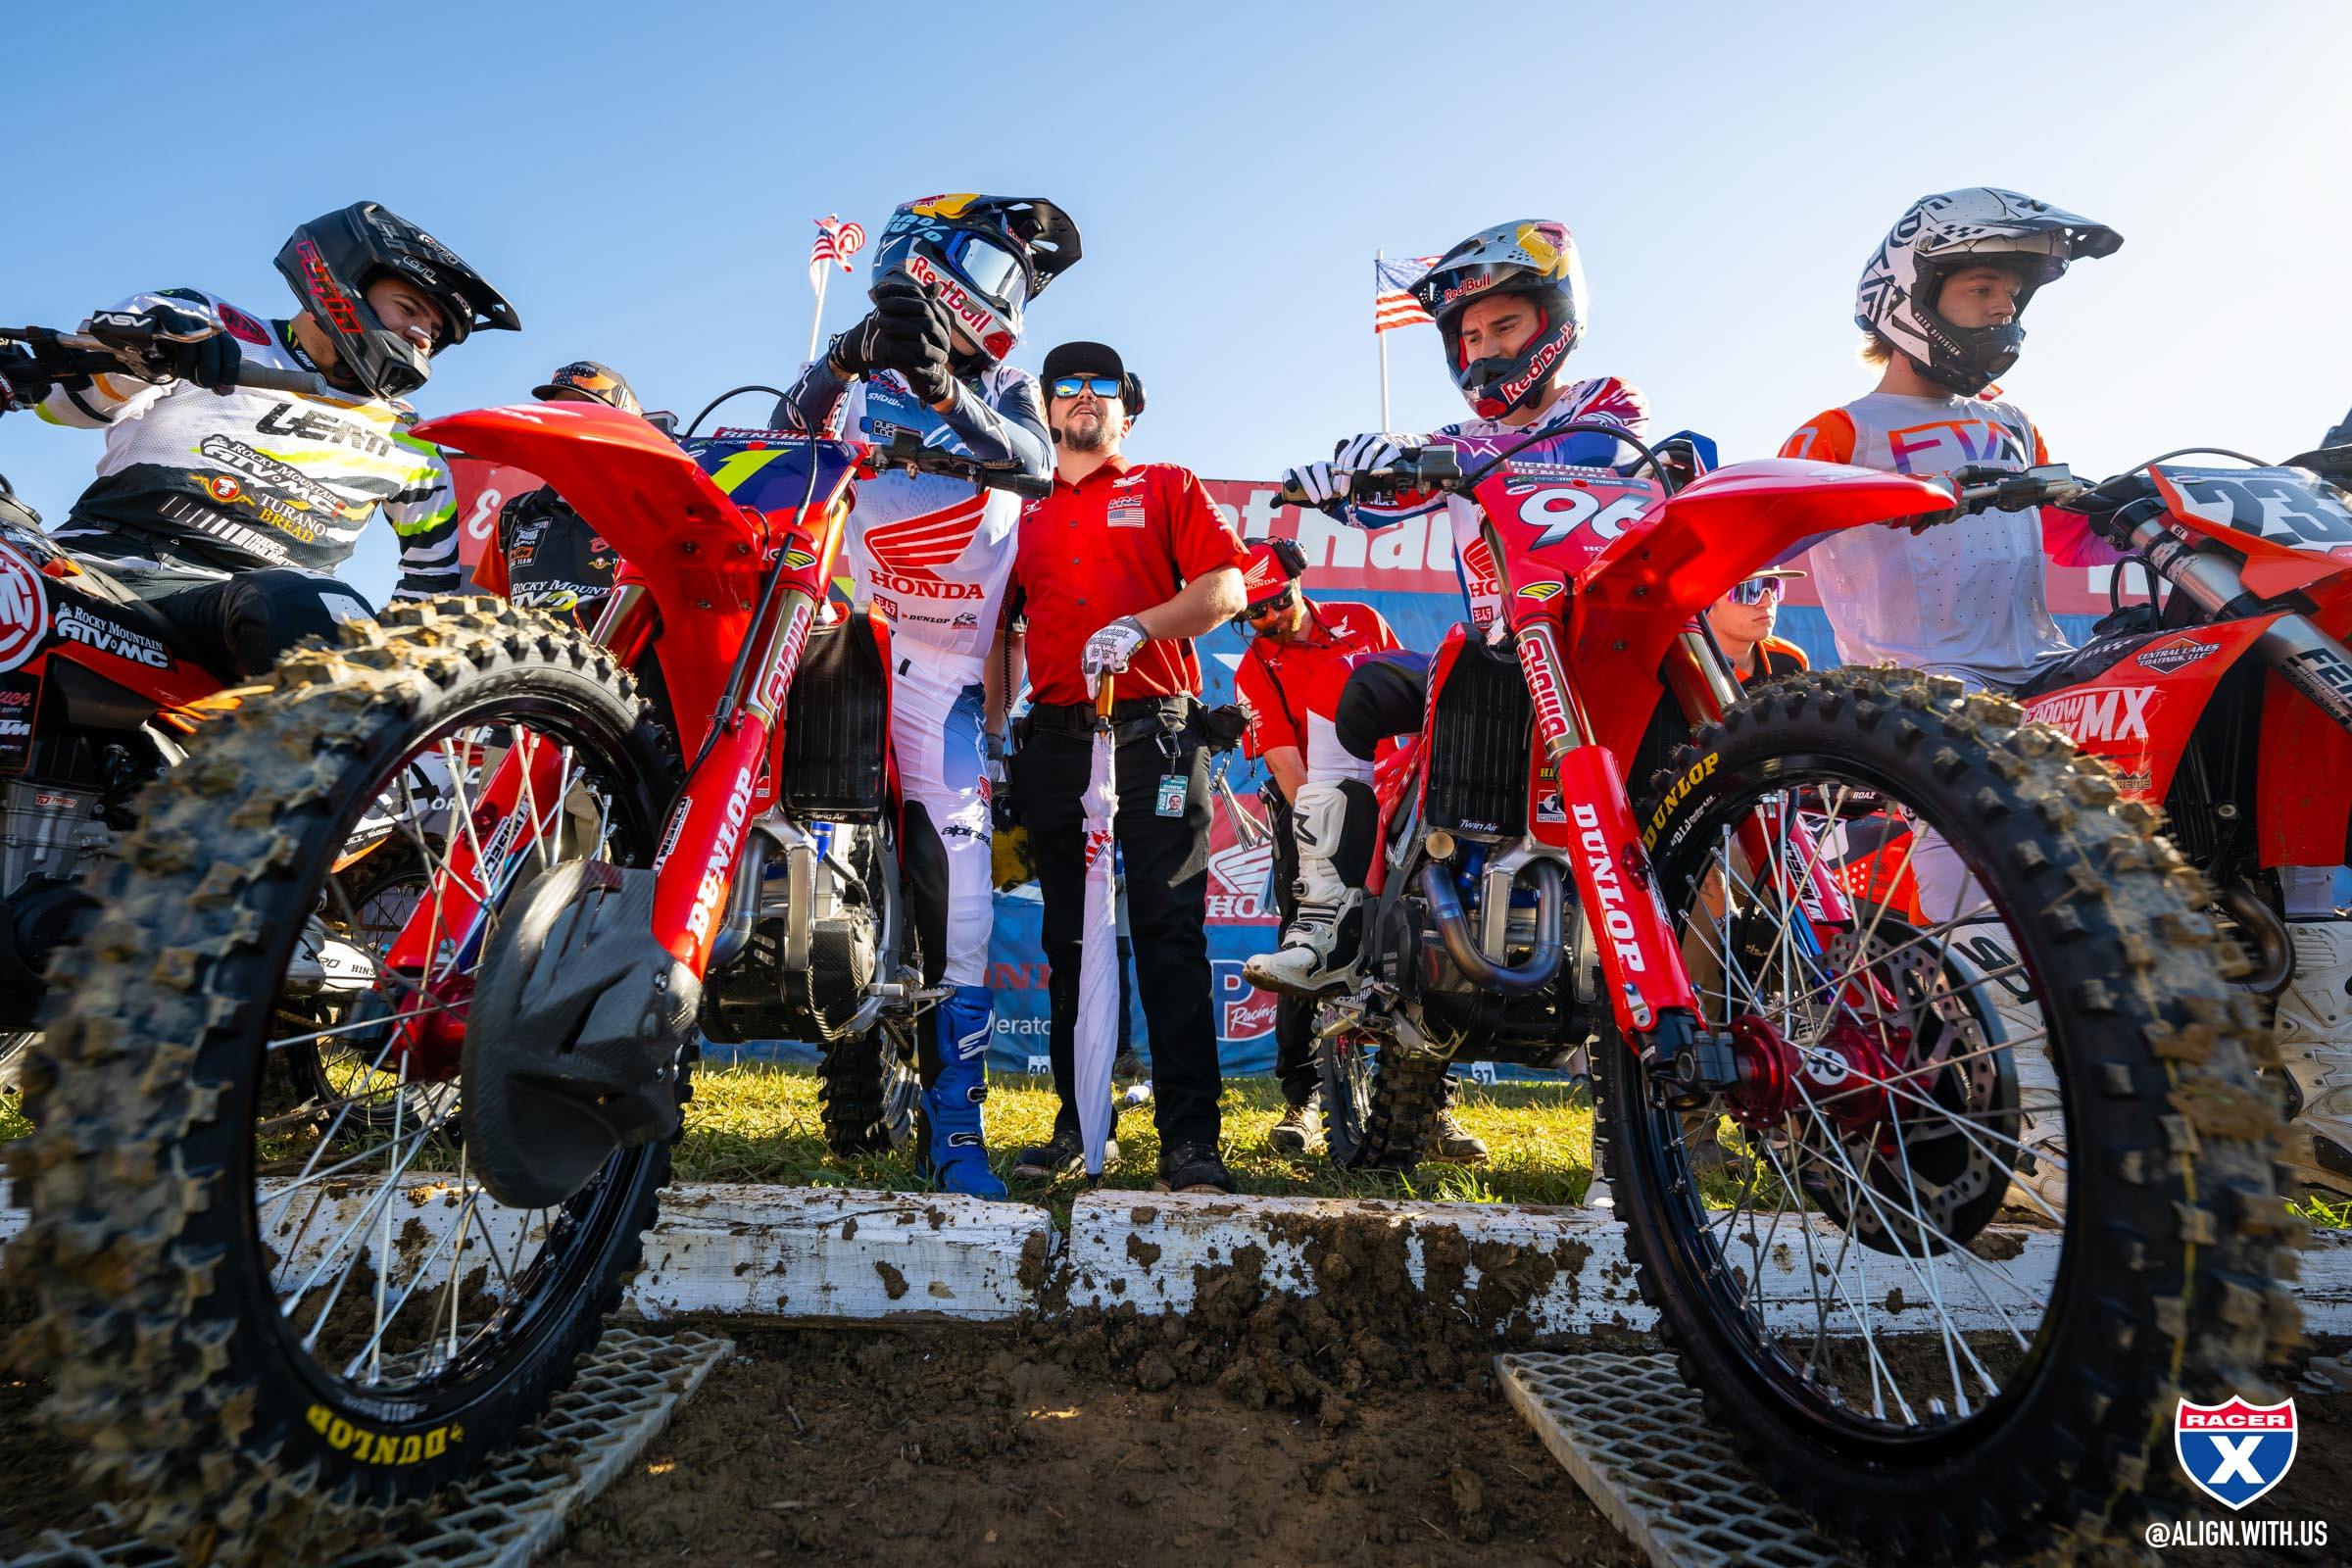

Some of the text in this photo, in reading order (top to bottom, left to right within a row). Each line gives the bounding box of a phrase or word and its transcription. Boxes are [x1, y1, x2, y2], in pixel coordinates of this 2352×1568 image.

[1445, 272, 1491, 303] Red Bull
[93, 313, 153, 327] ASV
[1914, 311, 1961, 357] MOTO DIVISION
[1500, 319, 1576, 406] Red Bull
[230, 443, 339, 506] ROCKY MOUNTAIN
[711, 449, 793, 496] 1
[258, 508, 315, 545] BREAD
[260, 493, 327, 537] TURANO
[1519, 487, 1654, 553] 96
[243, 540, 303, 567] UNLIMIT
[250, 531, 288, 556] RIDES
[512, 579, 611, 596] ROCKY MOUNT
[868, 567, 986, 601] HONDA
[74, 606, 164, 652] ROCKY MOUNTAIN
[908, 614, 951, 624] DUNLOP
[2136, 643, 2221, 661] CENTRAL LAKES
[2186, 652, 2207, 661] LLC
[2078, 685, 2157, 744] MX
[1642, 752, 1720, 853] DUNLOP
[1852, 791, 1876, 800] BOAZ
[1458, 818, 1498, 833] Twin Air
[686, 766, 753, 947] DUNLOP
[1571, 803, 1645, 973] DUNLOP
[351, 964, 375, 976] HINS
[1474, 1068, 1493, 1084] 37
[306, 1402, 449, 1467] DUNLOP
